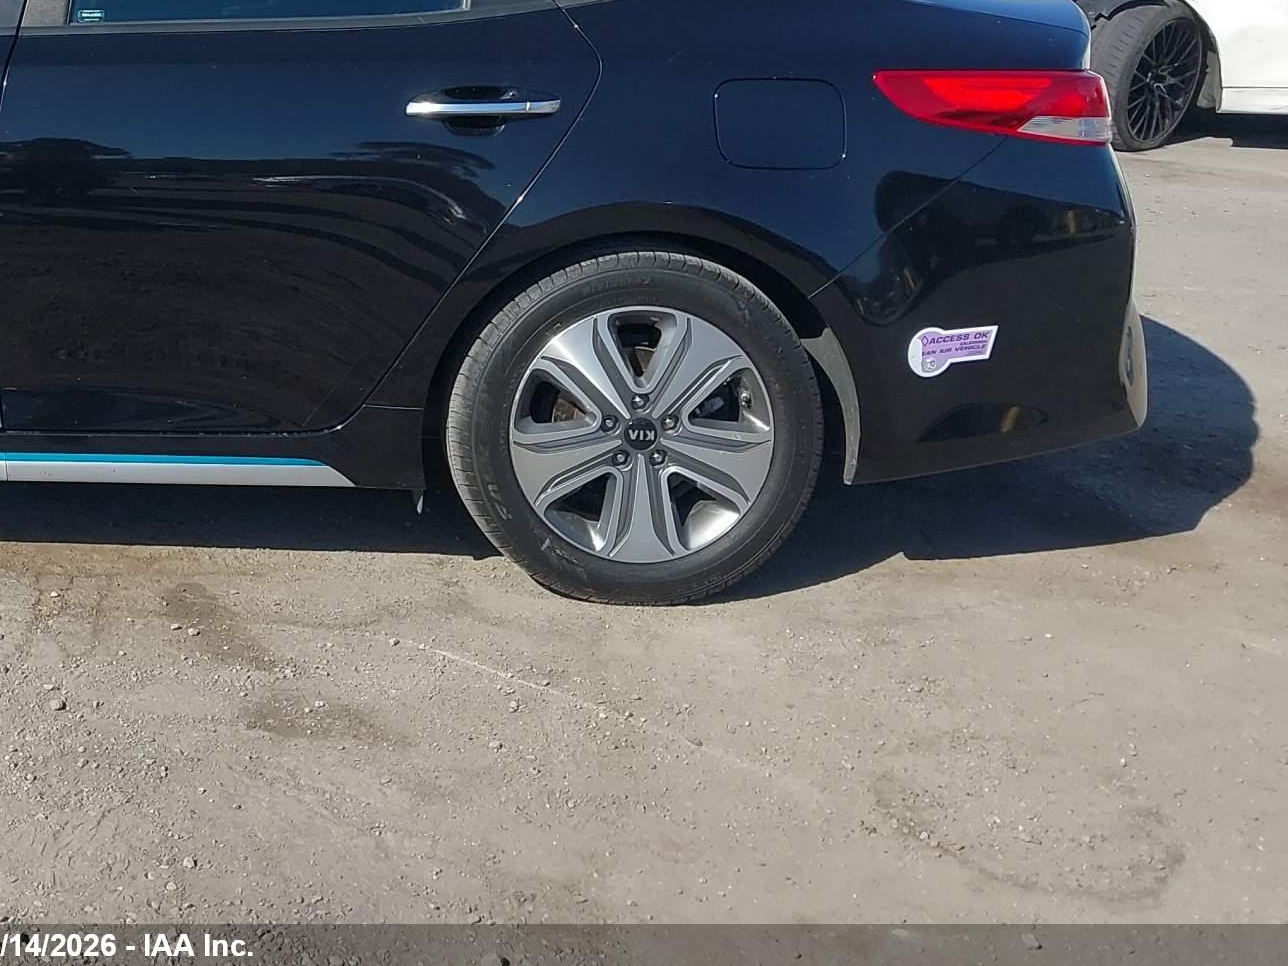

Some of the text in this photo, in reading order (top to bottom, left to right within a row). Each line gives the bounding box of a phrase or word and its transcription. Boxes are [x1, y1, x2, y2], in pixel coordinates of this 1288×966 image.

[929, 334, 969, 344] ACCESS
[954, 344, 985, 352] VEHICLE
[628, 429, 655, 441] KIA
